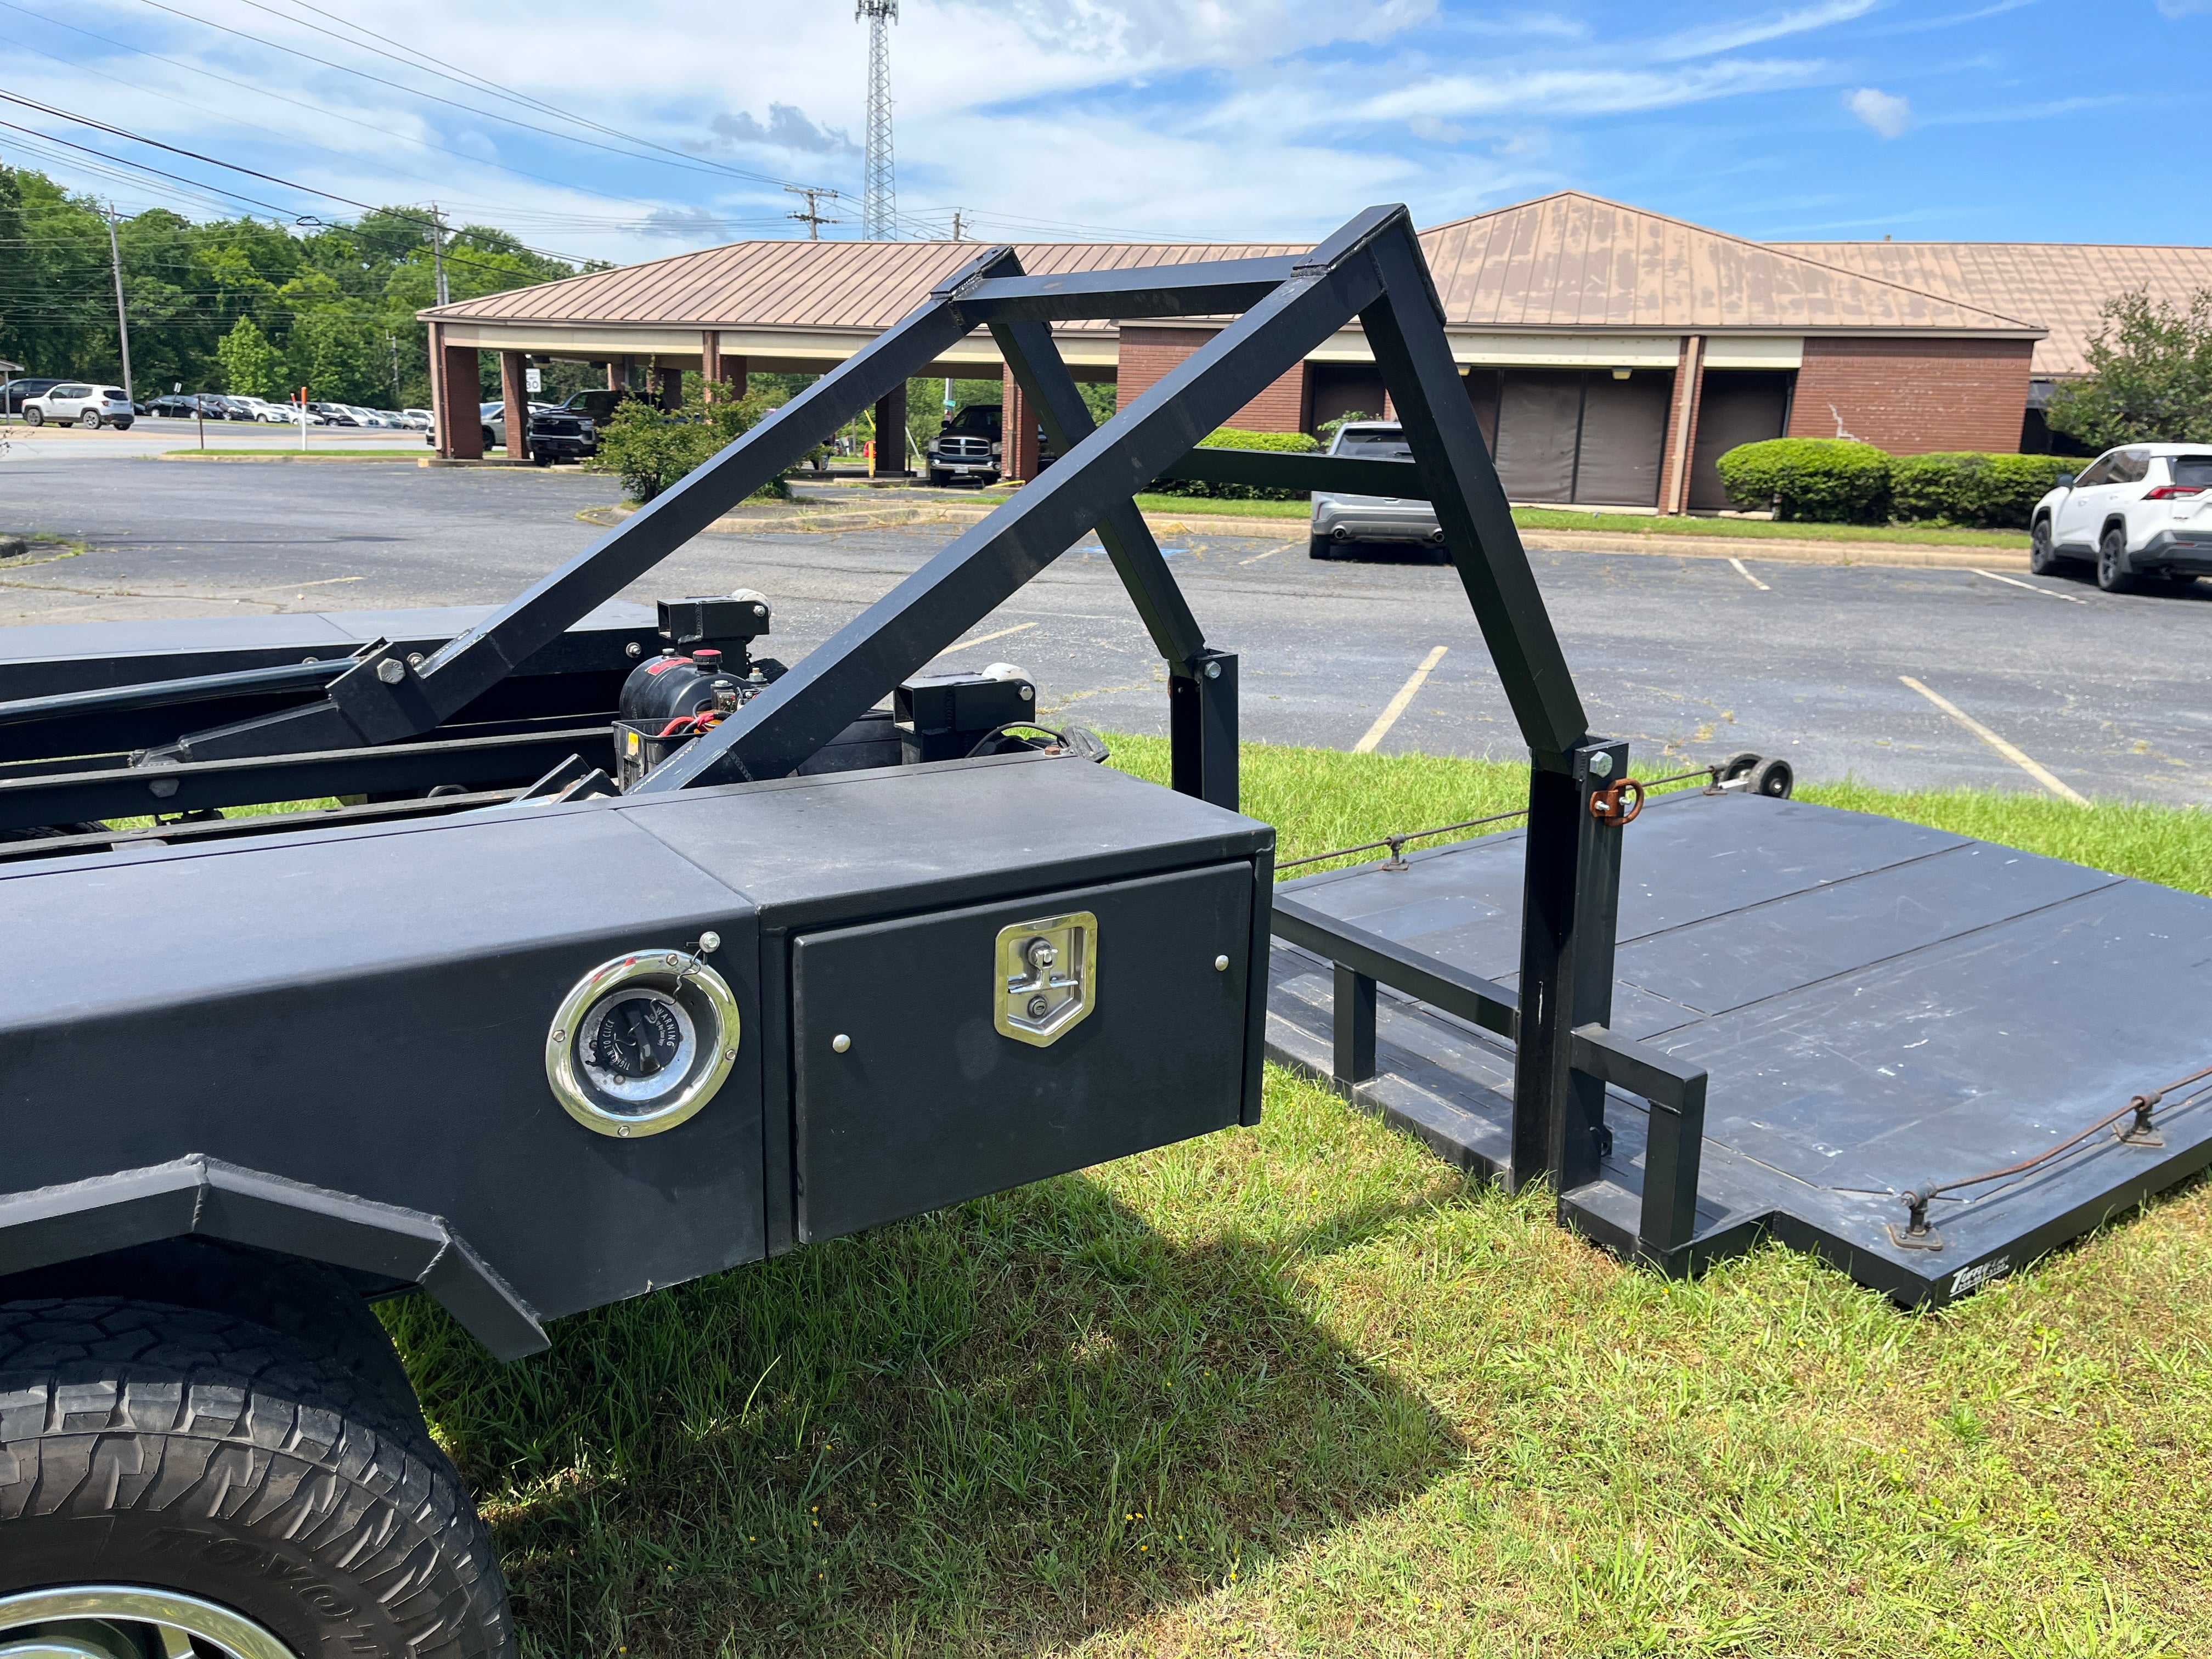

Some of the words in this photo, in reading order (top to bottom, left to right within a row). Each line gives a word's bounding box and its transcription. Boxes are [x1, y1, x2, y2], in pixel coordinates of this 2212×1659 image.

[602, 1019, 615, 1037] CLICK
[656, 1007, 675, 1047] WARNING
[603, 1040, 612, 1049] TO
